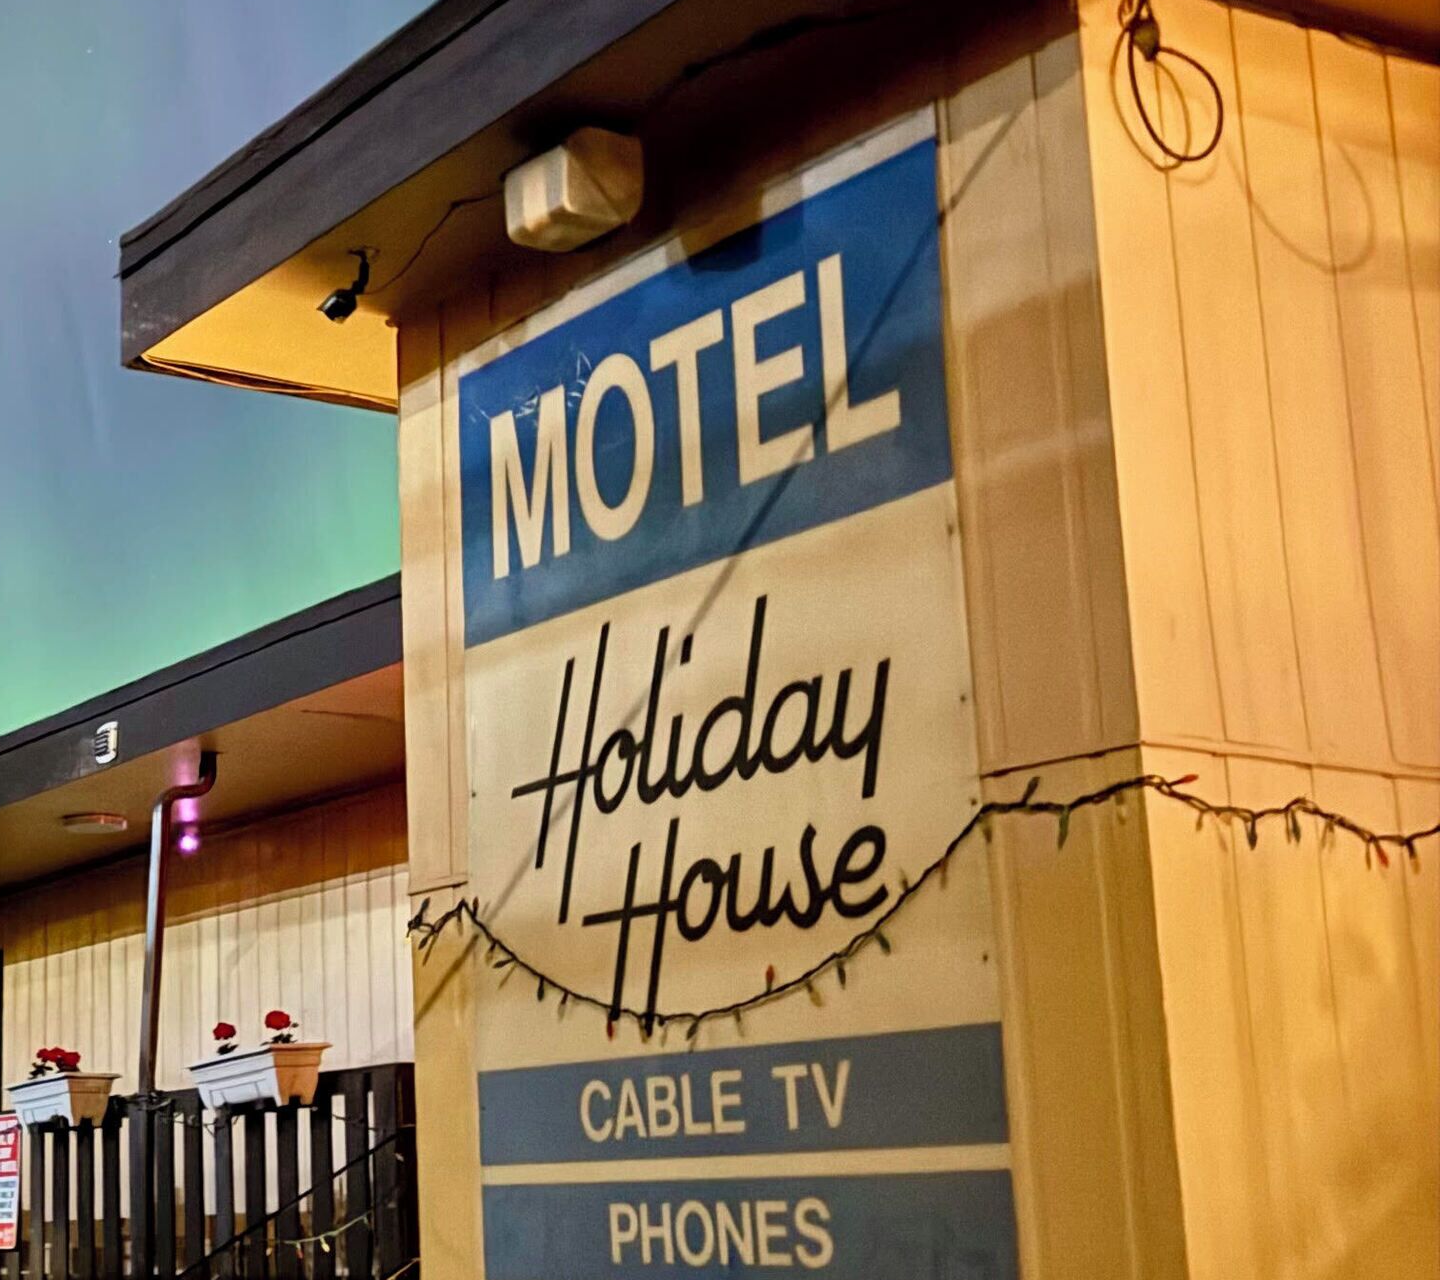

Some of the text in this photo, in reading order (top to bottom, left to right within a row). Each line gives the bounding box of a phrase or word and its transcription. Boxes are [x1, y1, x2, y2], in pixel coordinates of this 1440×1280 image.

[488, 253, 902, 580] MOTEL
[511, 595, 892, 924] Holiday
[583, 817, 890, 1034] House
[579, 1060, 851, 1142] CABLE TV
[609, 1197, 834, 1269] PHONES
